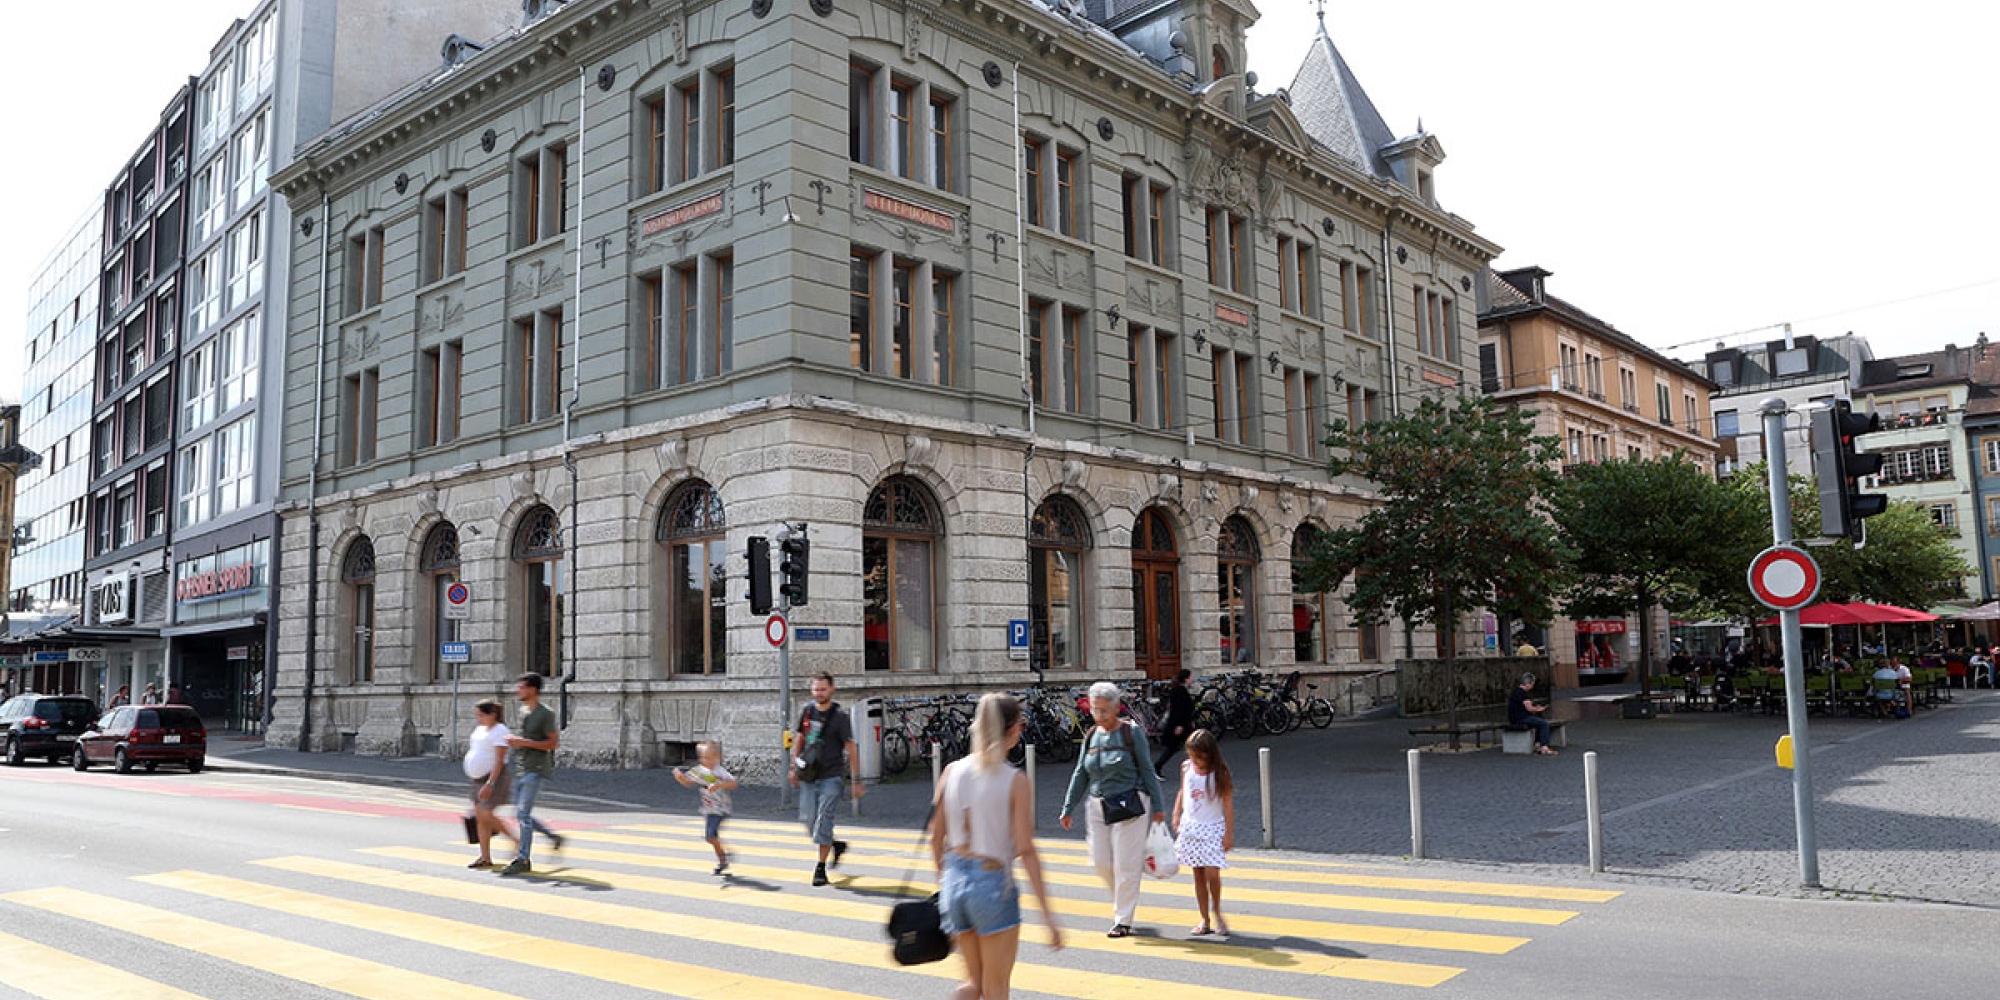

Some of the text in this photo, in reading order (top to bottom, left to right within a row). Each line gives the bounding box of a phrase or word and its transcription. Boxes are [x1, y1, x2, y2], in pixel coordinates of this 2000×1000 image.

[176, 561, 253, 601] OCHSNER SPORT
[101, 580, 122, 614] OVS
[1014, 623, 1024, 644] P
[75, 648, 102, 660] OVS
